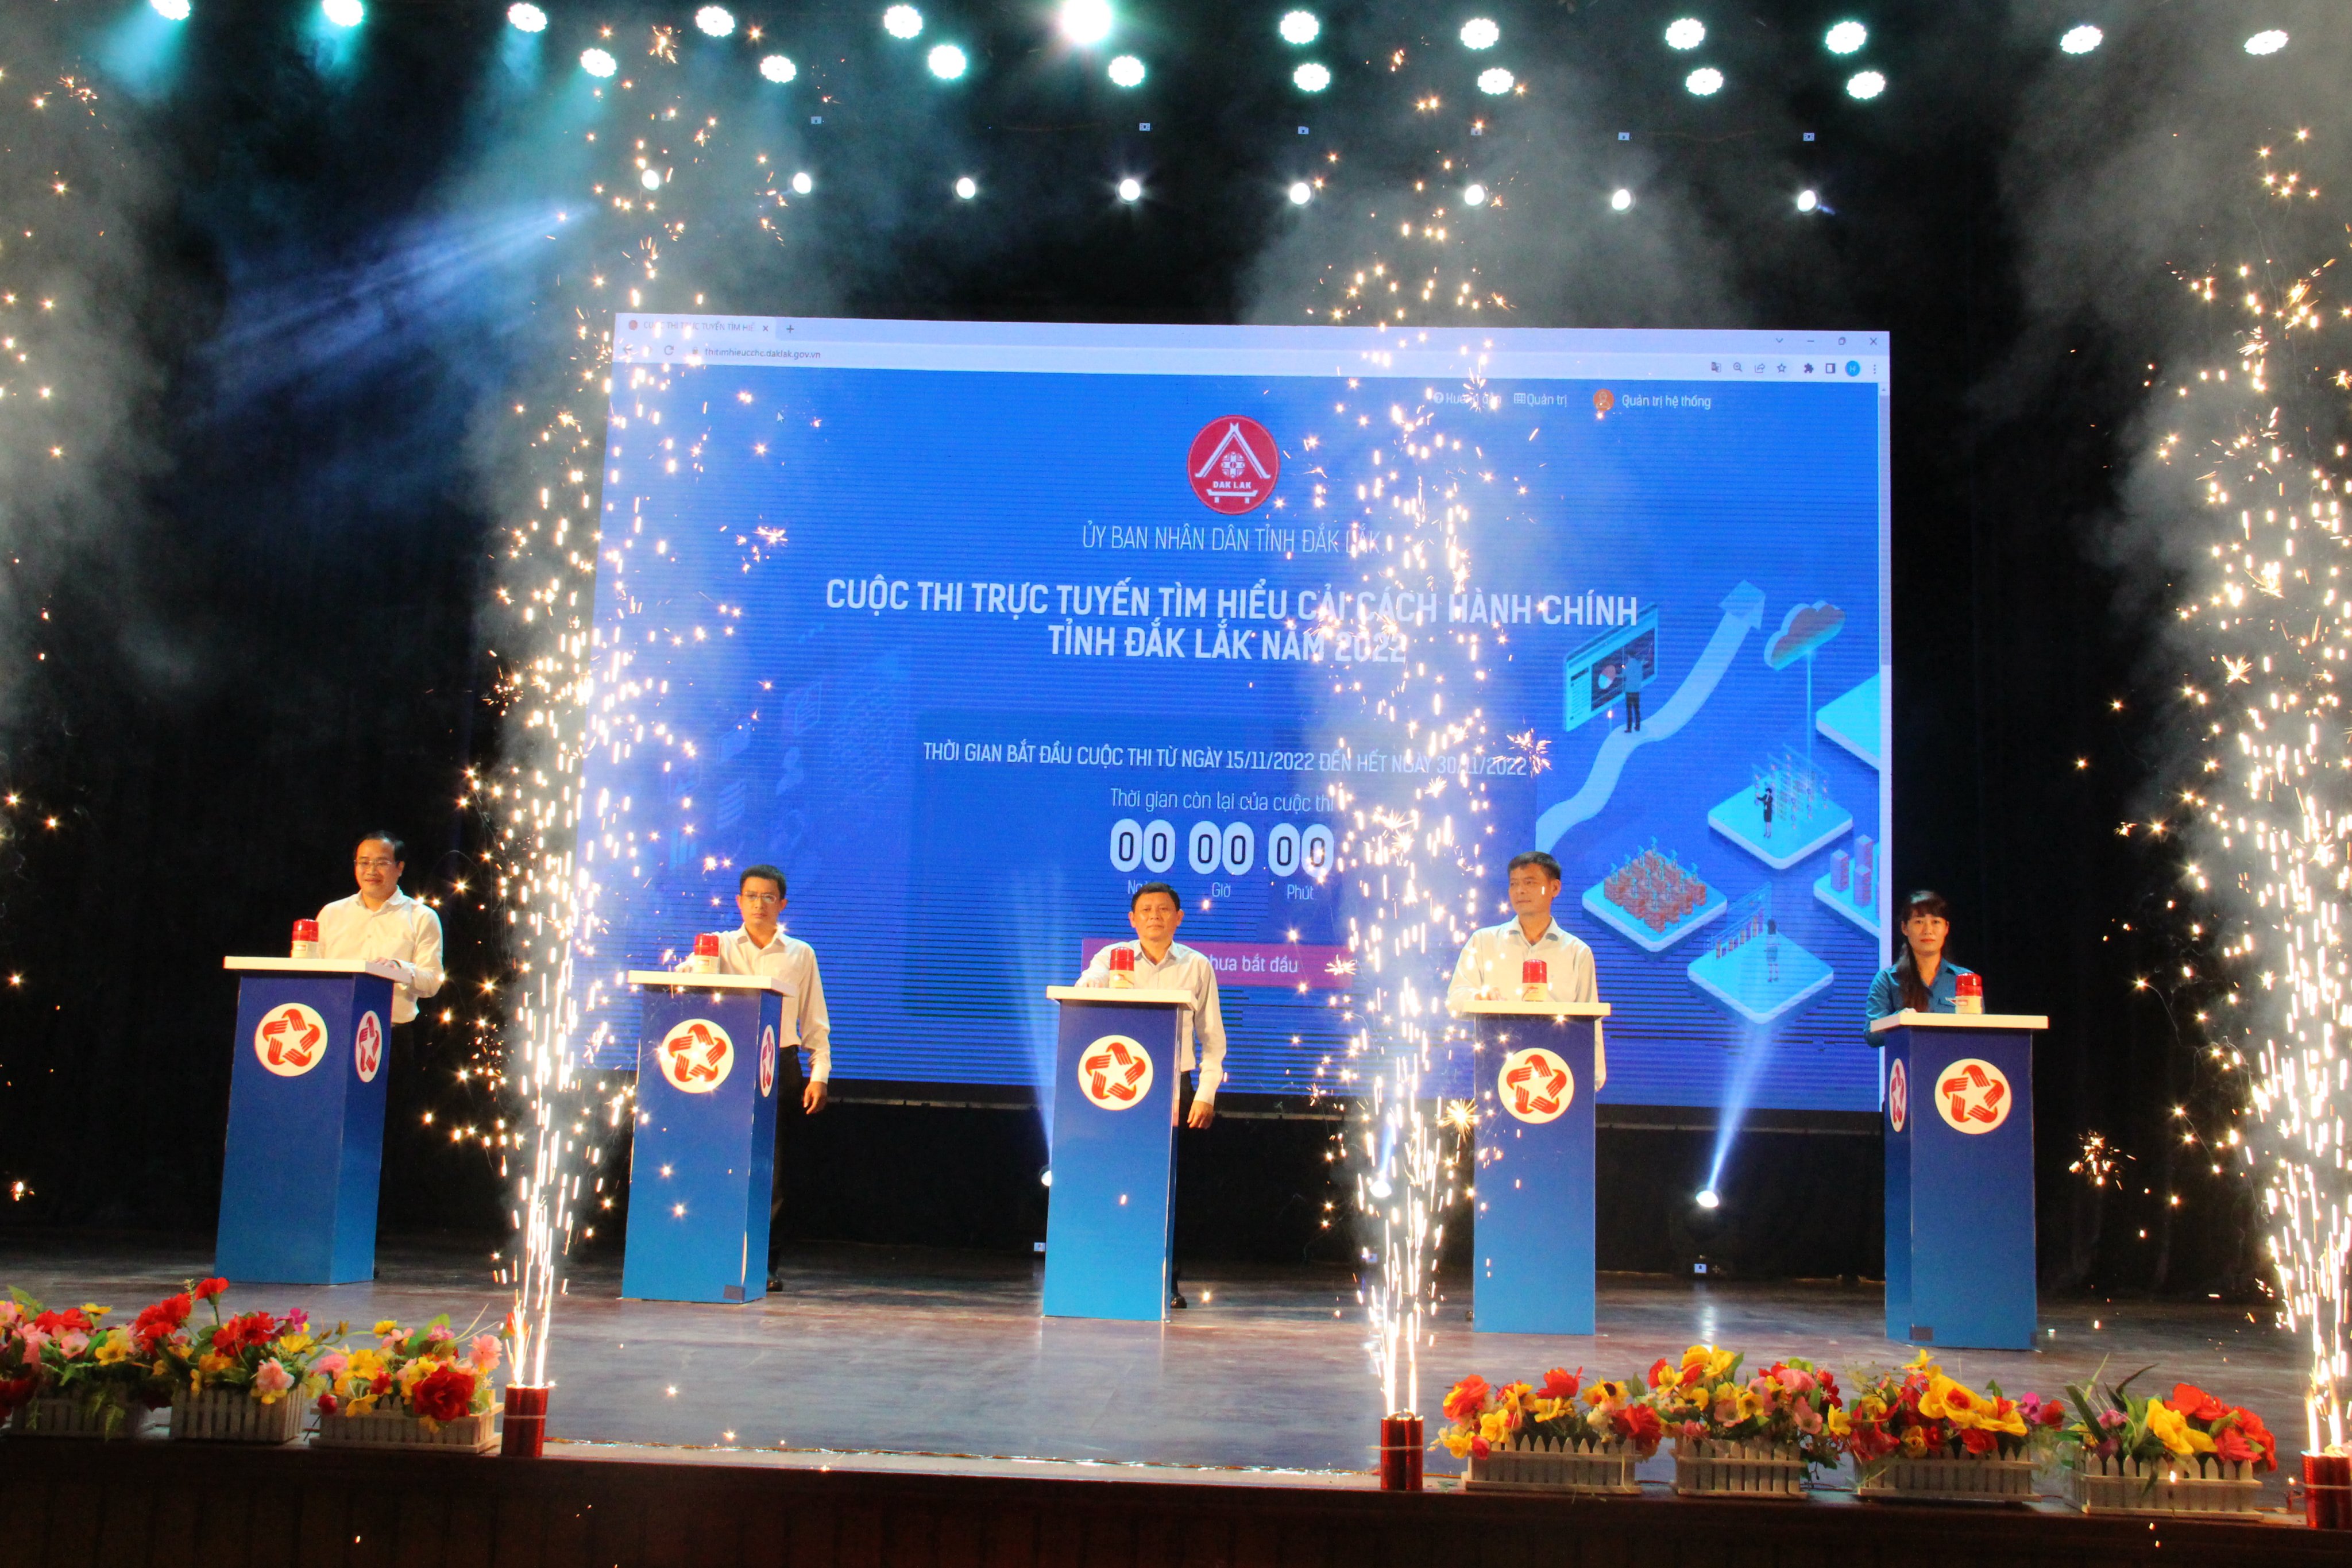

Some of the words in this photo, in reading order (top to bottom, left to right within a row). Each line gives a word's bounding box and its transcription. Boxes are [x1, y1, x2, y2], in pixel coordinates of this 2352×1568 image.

[1652, 395, 1663, 409] trị
[1666, 395, 1679, 409] hệ
[1083, 520, 1107, 549] ỦY
[1111, 526, 1148, 550] BAN
[1155, 522, 1204, 551] NHÂN
[1212, 523, 1249, 551] DÂN
[1254, 523, 1295, 552] TỈNH
[1302, 525, 1339, 553] ĐẮK
[826, 574, 909, 616] CUỘC
[918, 582, 963, 612] THI
[972, 581, 1049, 620] TRỰC
[1056, 576, 1149, 617] TUYẾN
[1158, 581, 1206, 618] TÌM
[1218, 578, 1287, 620] HIỂU
[1298, 583, 1345, 621] CẢI
[1357, 585, 1437, 623] CÁCH
[1449, 587, 1531, 624] HÀNH
[1542, 588, 1637, 626] CHÍNH
[1048, 617, 1114, 655] TỈNH
[1124, 616, 1185, 657] ĐẮK
[1195, 617, 1252, 660] LẮK
[1262, 621, 1324, 661] NĂM
[1334, 631, 1405, 663] 2022
[924, 739, 959, 761] THỜI
[964, 743, 1002, 763] GIAN
[1007, 739, 1036, 763] BẮT
[1040, 740, 1072, 764] ĐẦU
[1077, 744, 1123, 768] CUỘC
[1127, 748, 1152, 766] THI
[1156, 745, 1177, 767] TỪ
[1181, 747, 1223, 768] NGÀY
[1226, 751, 1314, 771] 15/11/2022
[1319, 748, 1351, 772] ĐẾN
[1357, 748, 1388, 773] HẾT
[1392, 750, 1432, 774] NGÀY
[1437, 755, 1527, 775] 30/11/2022
[1111, 787, 1140, 808] Thời
[1146, 791, 1177, 812] gian
[1183, 790, 1211, 809] còn
[1216, 791, 1235, 812] lại
[1240, 791, 1268, 810] của
[1273, 794, 1311, 813] cuộc
[1315, 795, 1334, 812] thi
[1287, 884, 1314, 900] Phút
[1208, 954, 1237, 971] hưa
[1242, 953, 1266, 972] bắt
[1270, 955, 1298, 972] đầu
